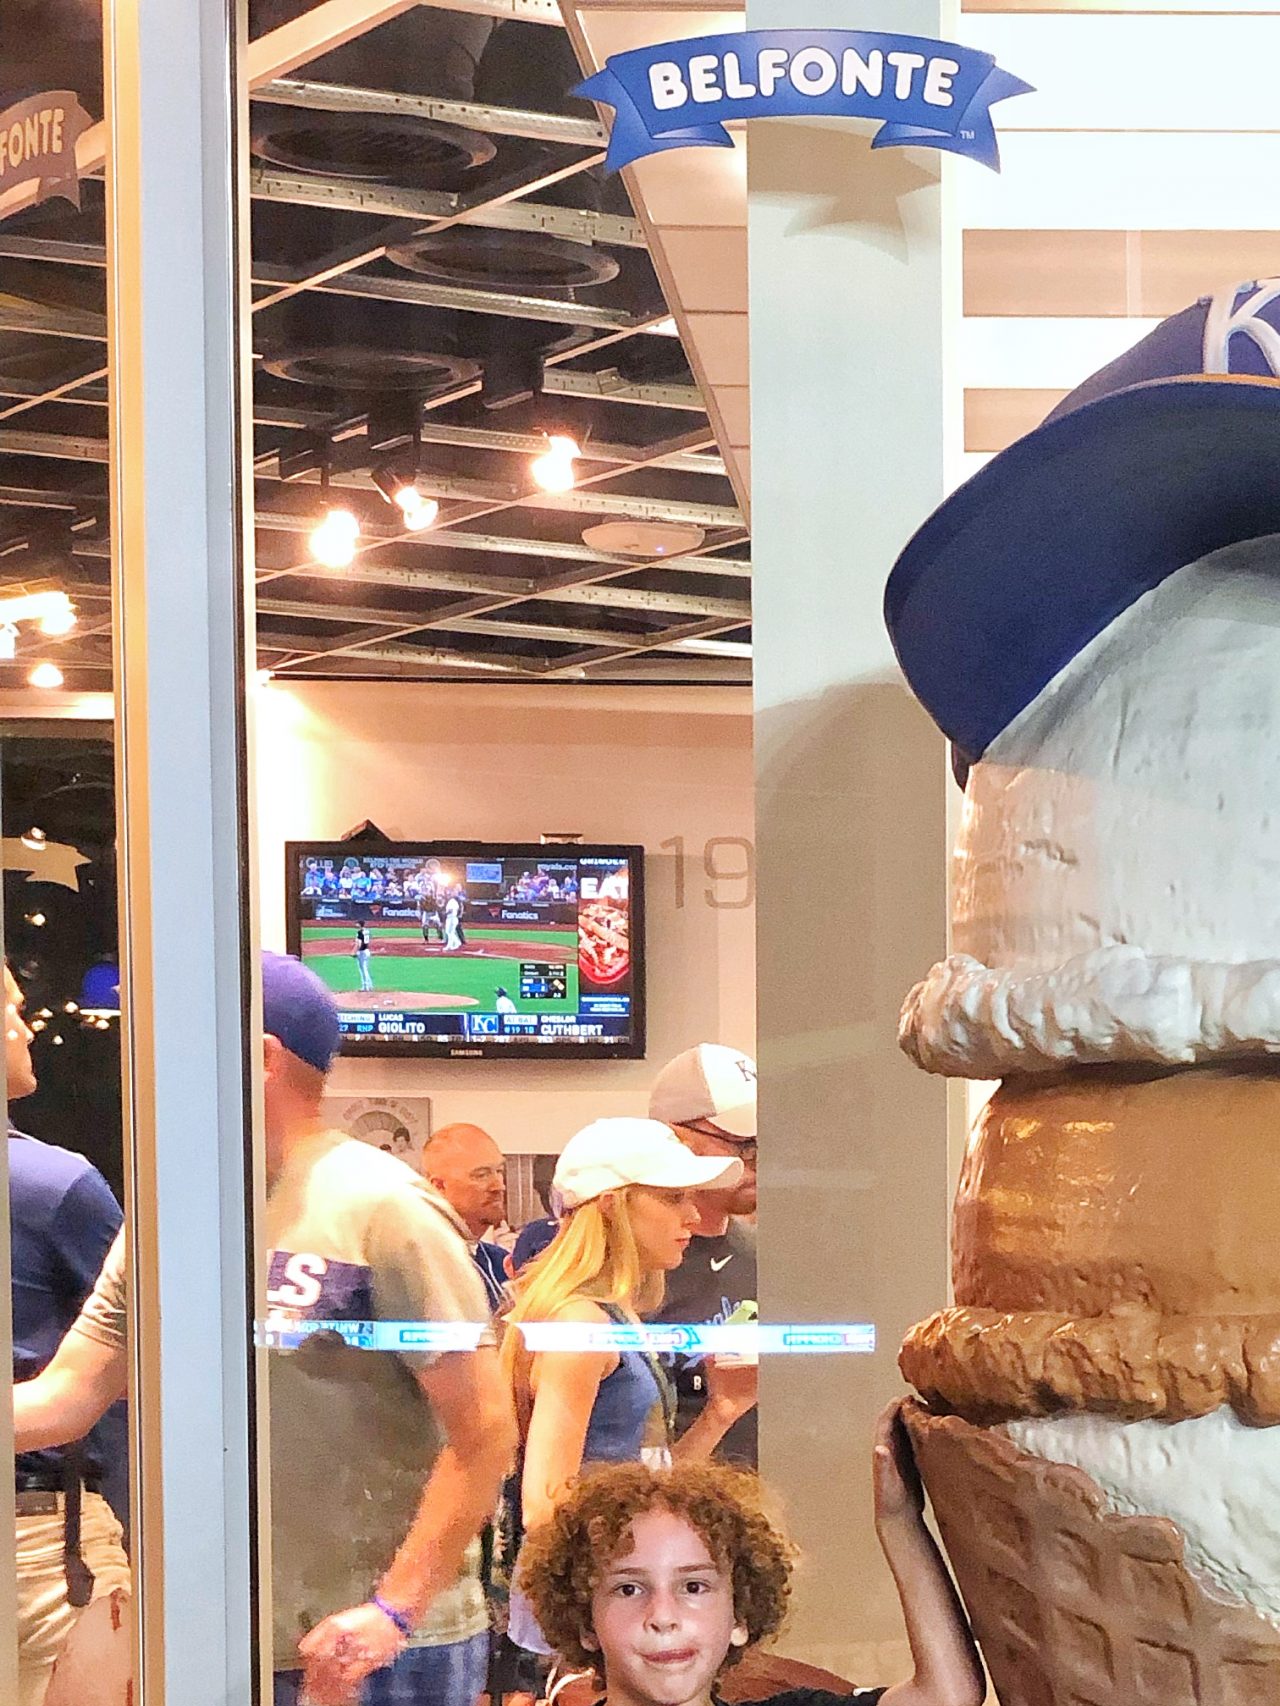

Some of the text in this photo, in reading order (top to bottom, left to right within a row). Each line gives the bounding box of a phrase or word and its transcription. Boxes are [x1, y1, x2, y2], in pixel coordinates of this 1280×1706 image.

[648, 46, 960, 111] BELFONTE
[378, 1013, 404, 1022] LUCAS
[378, 1022, 426, 1034] GIOLITO
[541, 1024, 604, 1036] CUTHBERT
[267, 1252, 328, 1307] S
